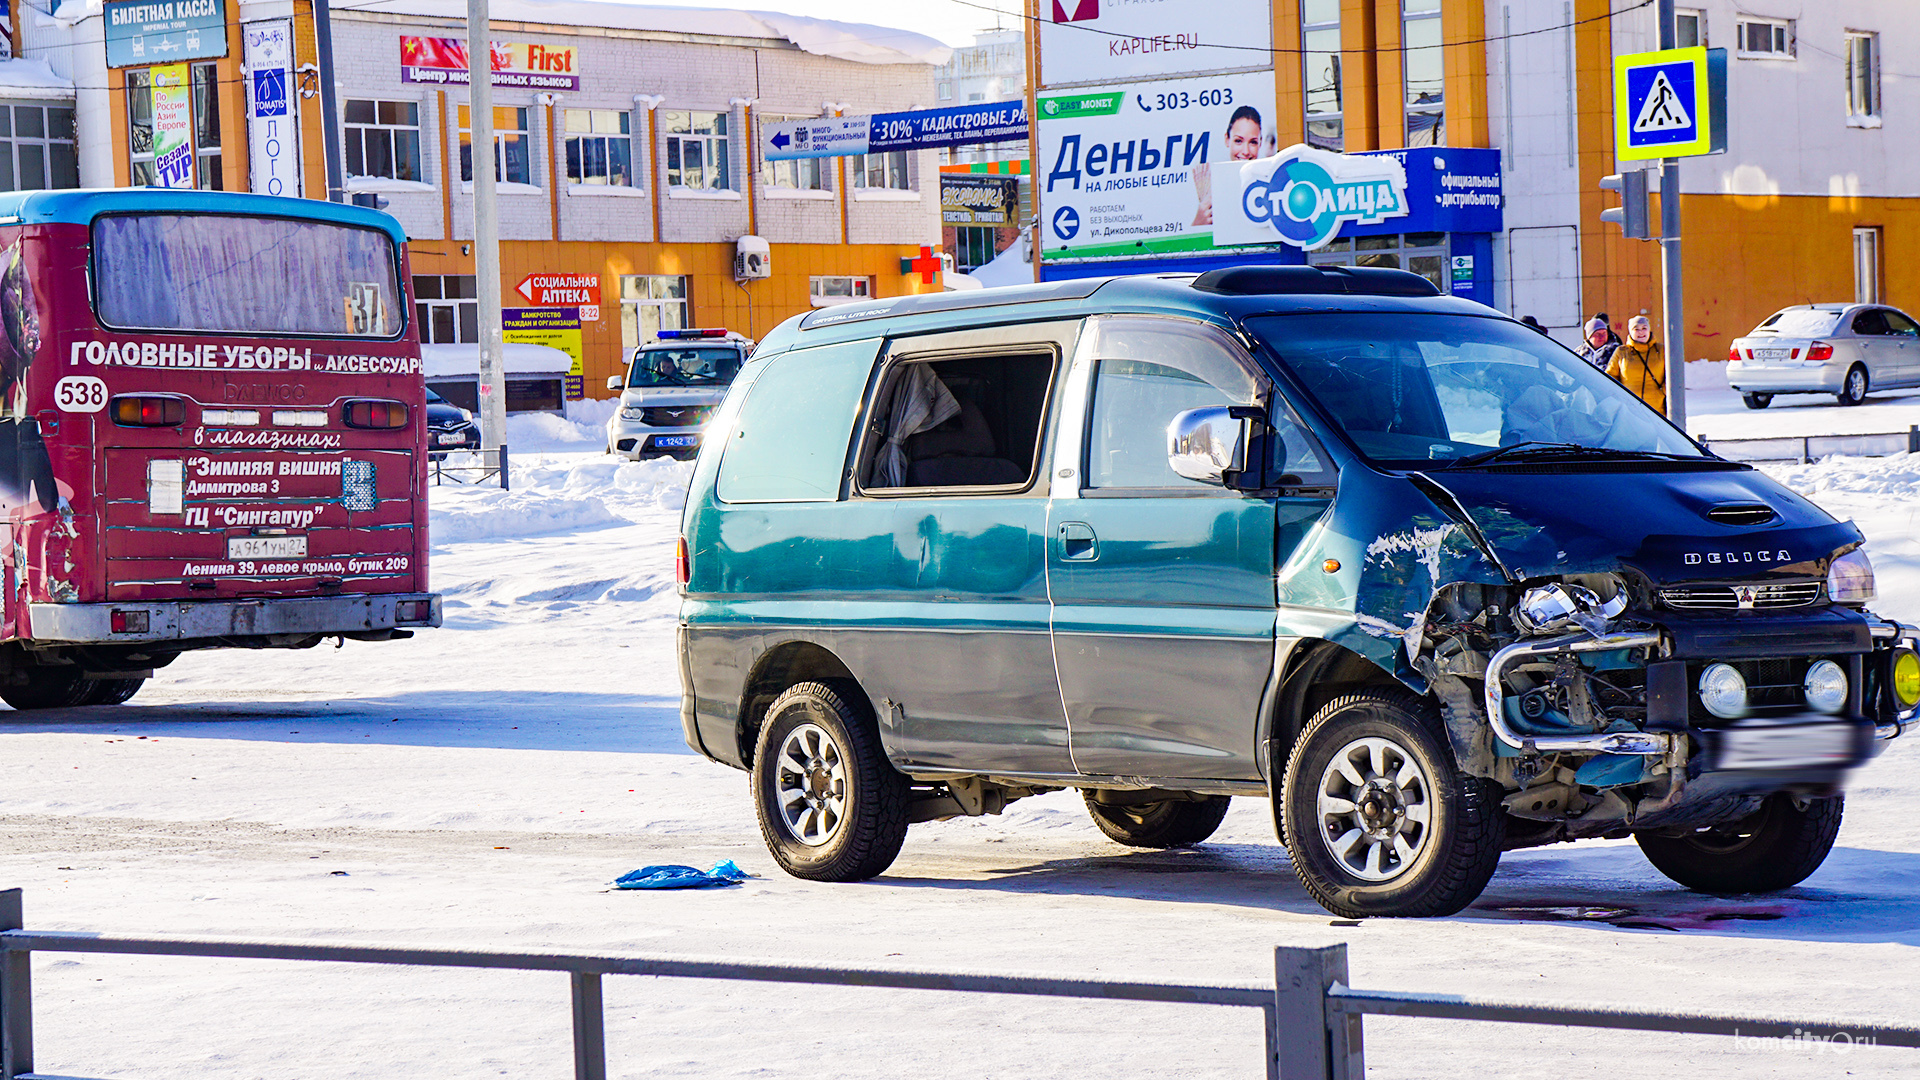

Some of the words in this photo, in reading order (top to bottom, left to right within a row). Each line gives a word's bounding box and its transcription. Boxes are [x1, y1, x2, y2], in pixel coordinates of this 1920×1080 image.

[111, 3, 173, 26] БИЛЕТНАЯ
[176, 0, 217, 18] КАССА
[143, 23, 170, 31] IMPERIAL
[1109, 32, 1198, 57] KAPLIFE.RU
[527, 43, 572, 72] First
[409, 67, 447, 83] Центр
[529, 76, 573, 89] языков
[155, 92, 167, 101] По
[254, 99, 285, 110] TOMATIS
[1060, 98, 1113, 110] EASYMONEY
[1156, 88, 1234, 111] 303-603
[156, 102, 185, 111] России
[157, 112, 177, 121] Азии
[921, 109, 1007, 133] КАДАСТРОВЫЕ
[1011, 107, 1029, 124] РА
[157, 121, 187, 132] Европе
[874, 118, 913, 140] -30%
[812, 131, 867, 143] ФУНКЦИОНАЛЬНЫЙ
[156, 142, 190, 169] Сезам
[812, 143, 829, 151] ОФИС
[1046, 131, 1211, 193] Деньги
[1085, 181, 1102, 193] НА
[1104, 176, 1149, 191] ЛЮБЫЕ
[1151, 171, 1188, 188] ЦЕЛИ!
[1441, 171, 1500, 191] официальный
[1441, 190, 1501, 209] дистрибьютор
[1089, 204, 1126, 214] РАБОТАЕМ
[1089, 216, 1103, 224] БЕЗ
[1104, 214, 1143, 224] ВЫХОДНЫХ
[1090, 228, 1102, 238] ул.
[1103, 223, 1163, 237] Дикопольцева
[1164, 222, 1184, 233] 29/1
[533, 276, 598, 289] СОЦИАЛЬНАЯ
[541, 289, 592, 303] АПТЕКА
[351, 283, 379, 334] 37
[580, 307, 598, 318] 8-22
[538, 318, 579, 327] ОРГАНИЗАЦИЙ
[70, 340, 218, 368] ГОЛОВНЫЕ
[222, 345, 312, 370] УБОРЫ
[60, 382, 103, 405] 538
[224, 383, 306, 401] DAEWOO
[194, 426, 204, 445] в
[210, 430, 341, 449] магазинах:
[666, 437, 684, 446] 1242
[187, 456, 275, 476] “Зимняя
[186, 479, 267, 496] Димитрова
[270, 479, 280, 493] 3
[185, 507, 209, 528] ТЦ
[214, 504, 324, 528] “Сингапур”
[234, 540, 286, 557] А961УН
[289, 538, 302, 550] 27
[1684, 549, 1792, 565] DELICA
[182, 562, 235, 576] Ленина
[237, 561, 258, 576] 39,
[260, 561, 300, 574] левое
[302, 561, 346, 575] крыло,
[348, 558, 385, 572] бутик
[386, 557, 409, 570] 209
